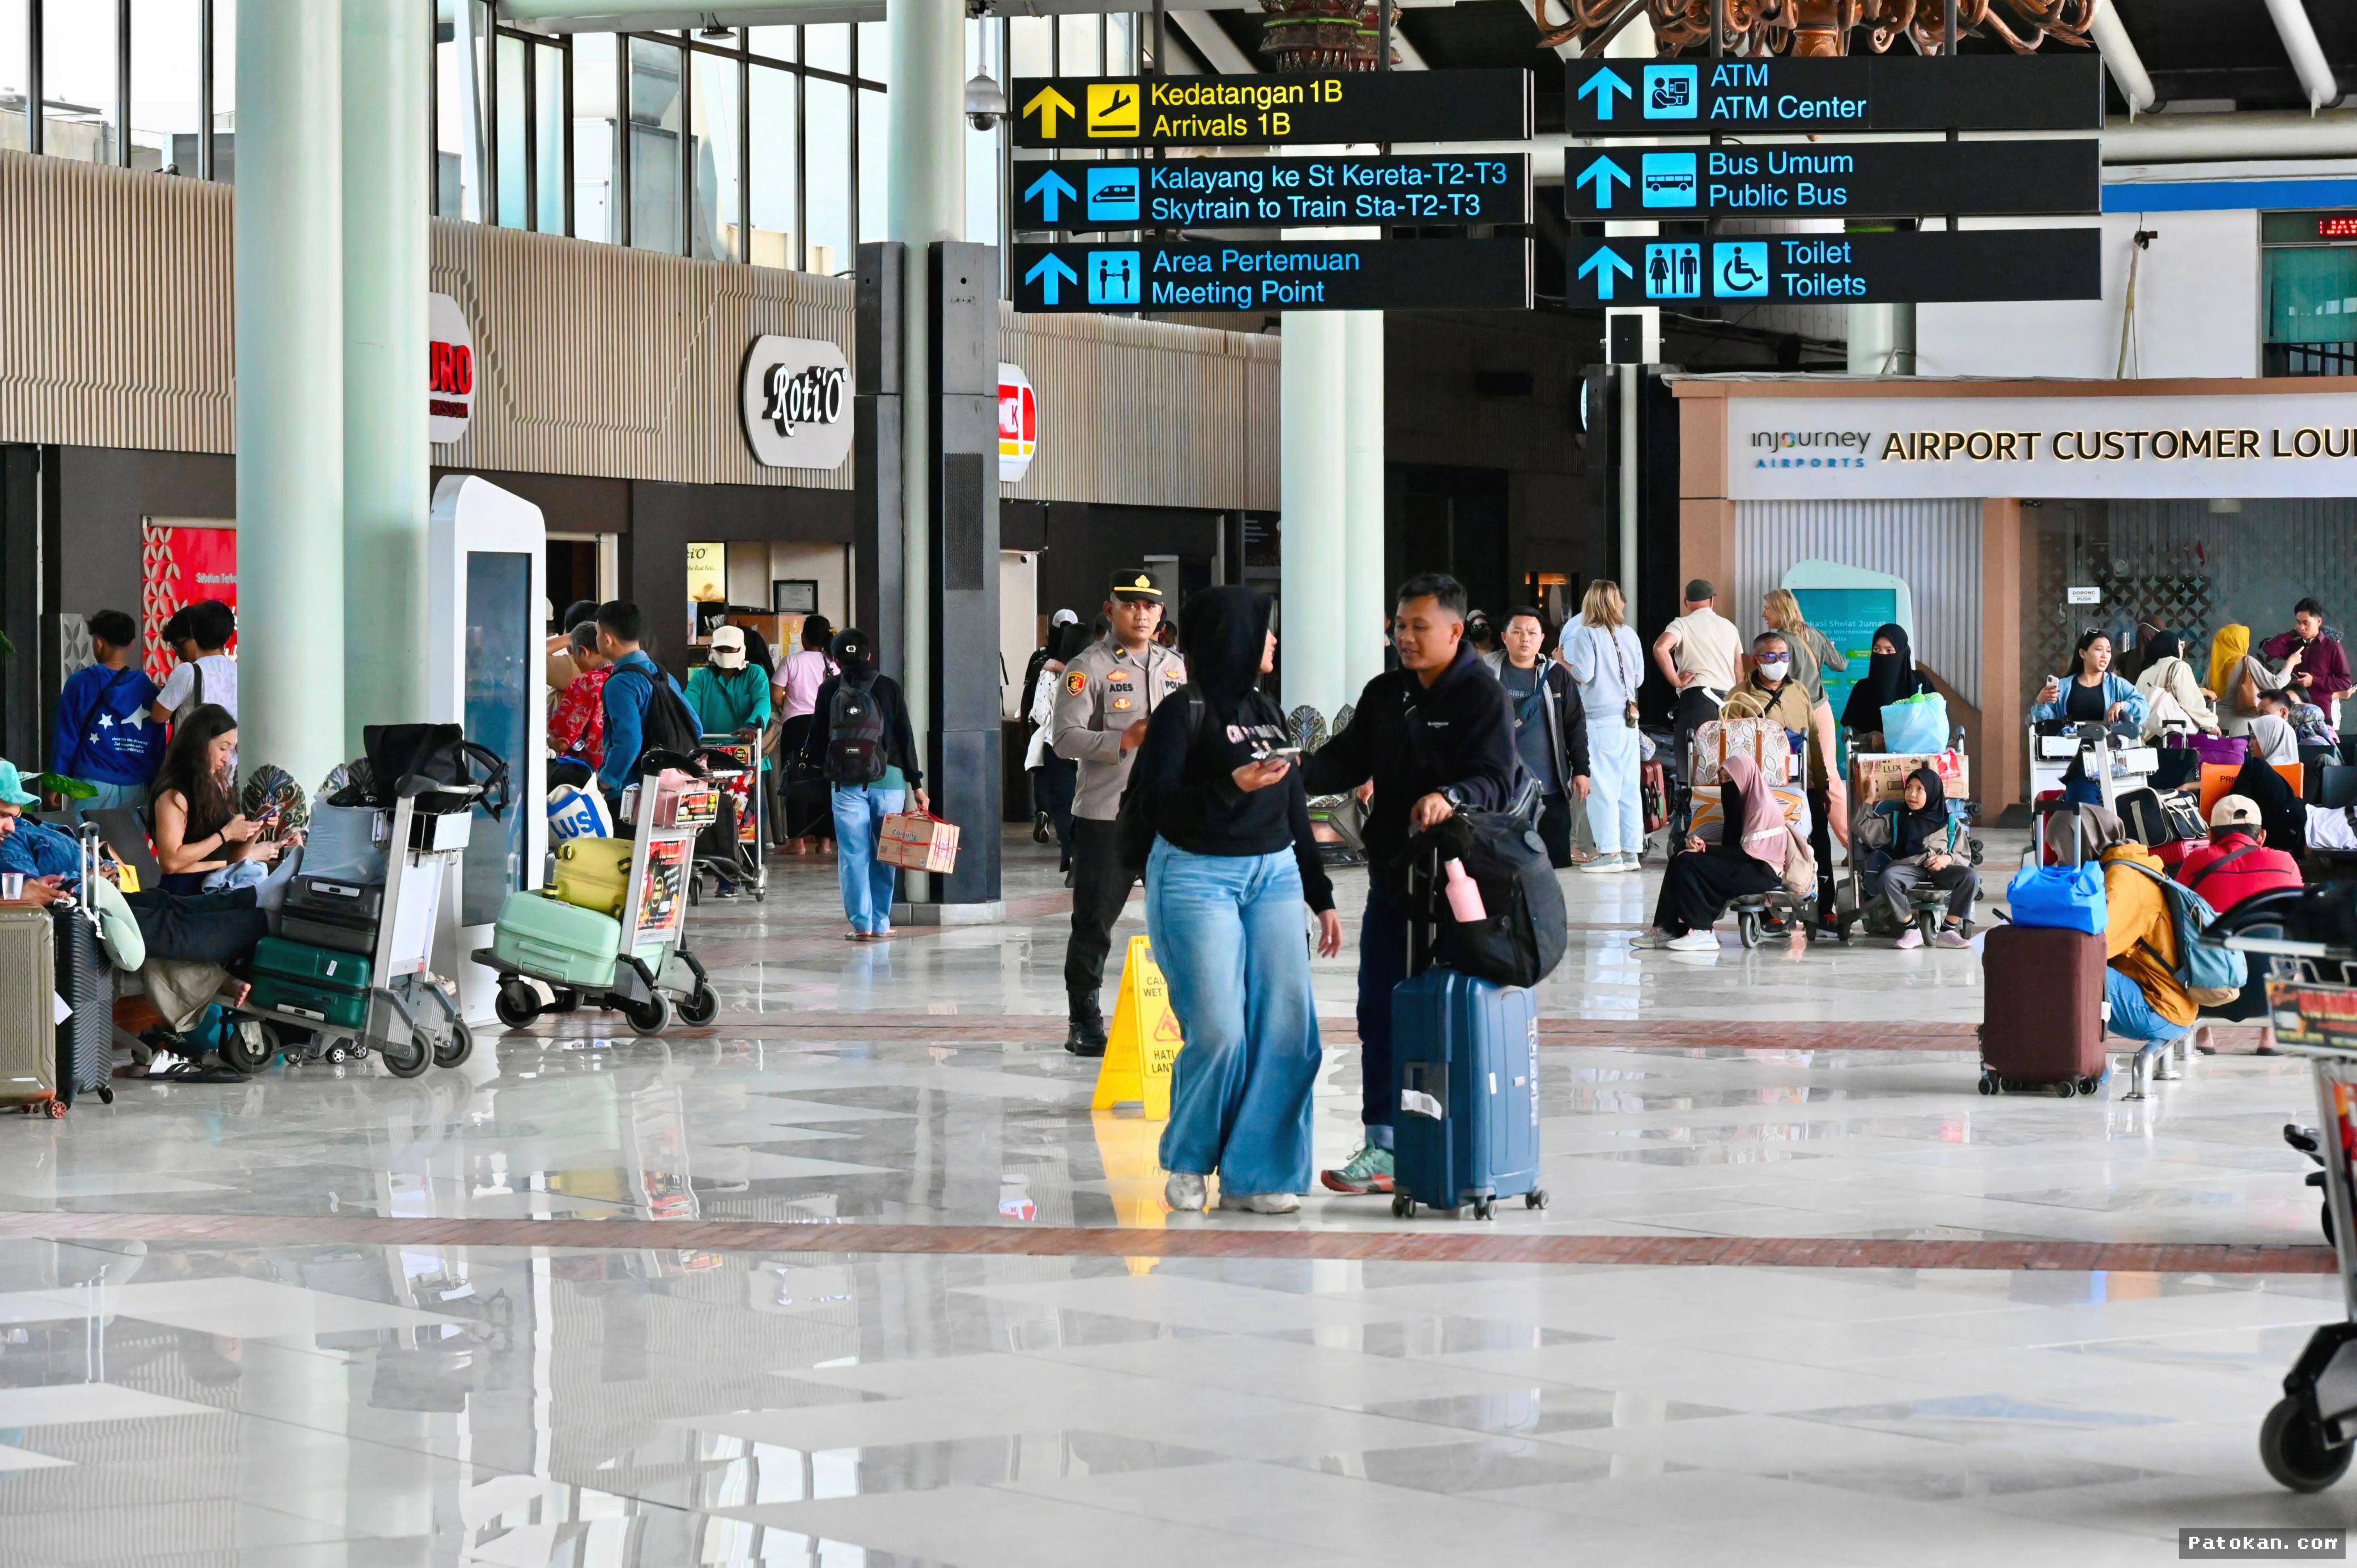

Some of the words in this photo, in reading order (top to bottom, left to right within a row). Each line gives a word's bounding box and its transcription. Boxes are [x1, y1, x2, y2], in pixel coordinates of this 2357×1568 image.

[1711, 64, 1768, 87] ATM
[1152, 83, 1303, 107] Kedatangan
[1309, 80, 1343, 103] 1B
[1710, 96, 1768, 119] ATM
[1777, 95, 1867, 119] Center
[1152, 113, 1248, 137] Arrivals
[1258, 112, 1291, 135] 1B
[1709, 152, 1759, 175] Bus
[1768, 151, 1853, 174] Umum
[1151, 166, 1263, 194] Kalayang
[1273, 165, 1300, 187] ke
[1308, 164, 1334, 187] St
[1343, 162, 1507, 186] Kereta-T2-T3
[1709, 183, 1788, 207] Public
[1798, 182, 1848, 206] Bus
[1151, 197, 1249, 223] Skytrain
[1257, 198, 1281, 218] to
[1287, 195, 1346, 218] Train
[1355, 194, 1480, 218] Sta-T2-T3
[1152, 250, 1212, 272] Area
[1222, 249, 1359, 272] Pertemuan
[1781, 240, 1852, 265] Toilet
[1152, 281, 1252, 309] Meeting
[1262, 280, 1325, 303] Point
[1781, 272, 1866, 297] Toilets
[1751, 432, 1871, 454] injourney
[1881, 431, 2043, 461] AIRPORT
[2052, 429, 2261, 460] CUSTOMER
[2273, 428, 2357, 458] LOU
[1756, 458, 1865, 468] AIRPORTS
[1109, 683, 1134, 692] ADES
[1883, 764, 1901, 773] LUX
[1143, 988, 1162, 997] WET
